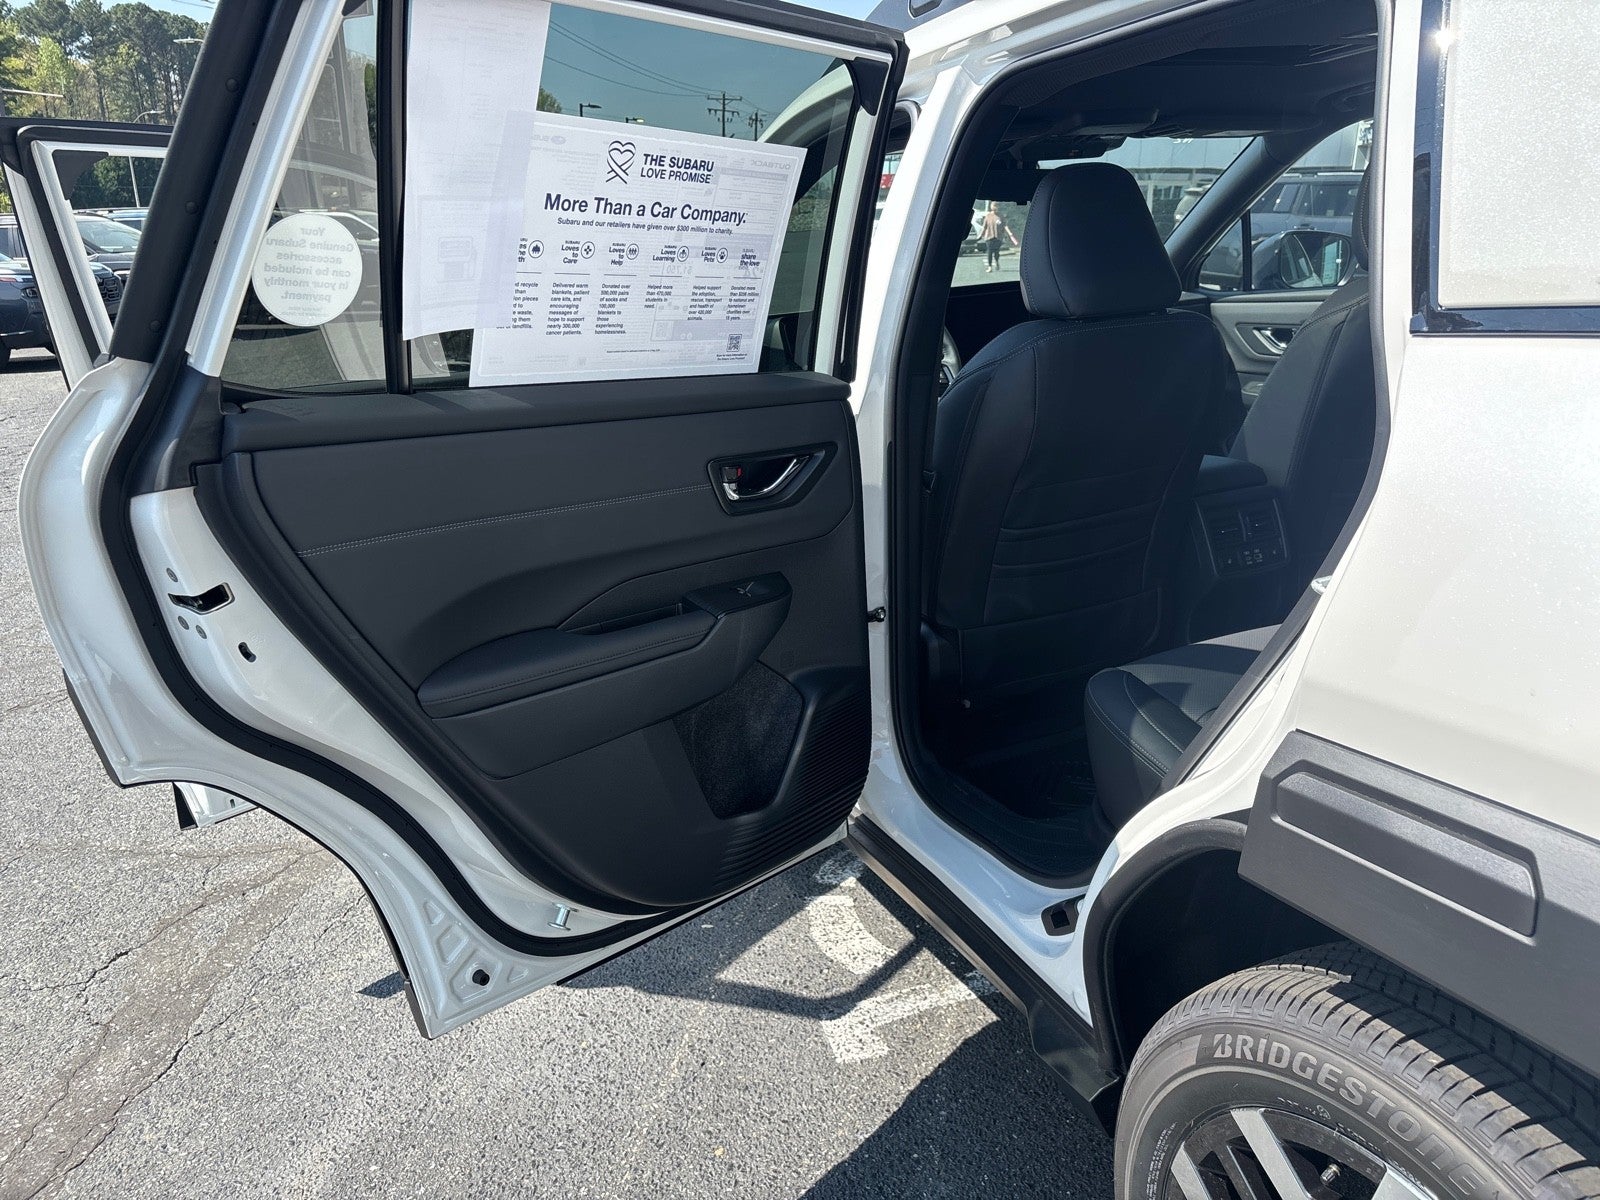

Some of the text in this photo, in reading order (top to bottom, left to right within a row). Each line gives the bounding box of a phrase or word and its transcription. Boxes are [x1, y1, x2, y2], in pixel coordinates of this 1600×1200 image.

[643, 153, 714, 172] THE SUBARU
[640, 168, 712, 184] LOVE PROMISE
[544, 192, 588, 213] More
[594, 196, 632, 216] Than
[636, 204, 646, 217] a
[650, 202, 678, 219] Car
[557, 217, 581, 227] Subaru
[607, 220, 630, 229] retailers
[632, 222, 645, 230] have
[646, 223, 662, 232] given
[690, 225, 708, 233] million
[715, 227, 733, 235] charity.
[1212, 1033, 1490, 1192] BRIDGESTONE
